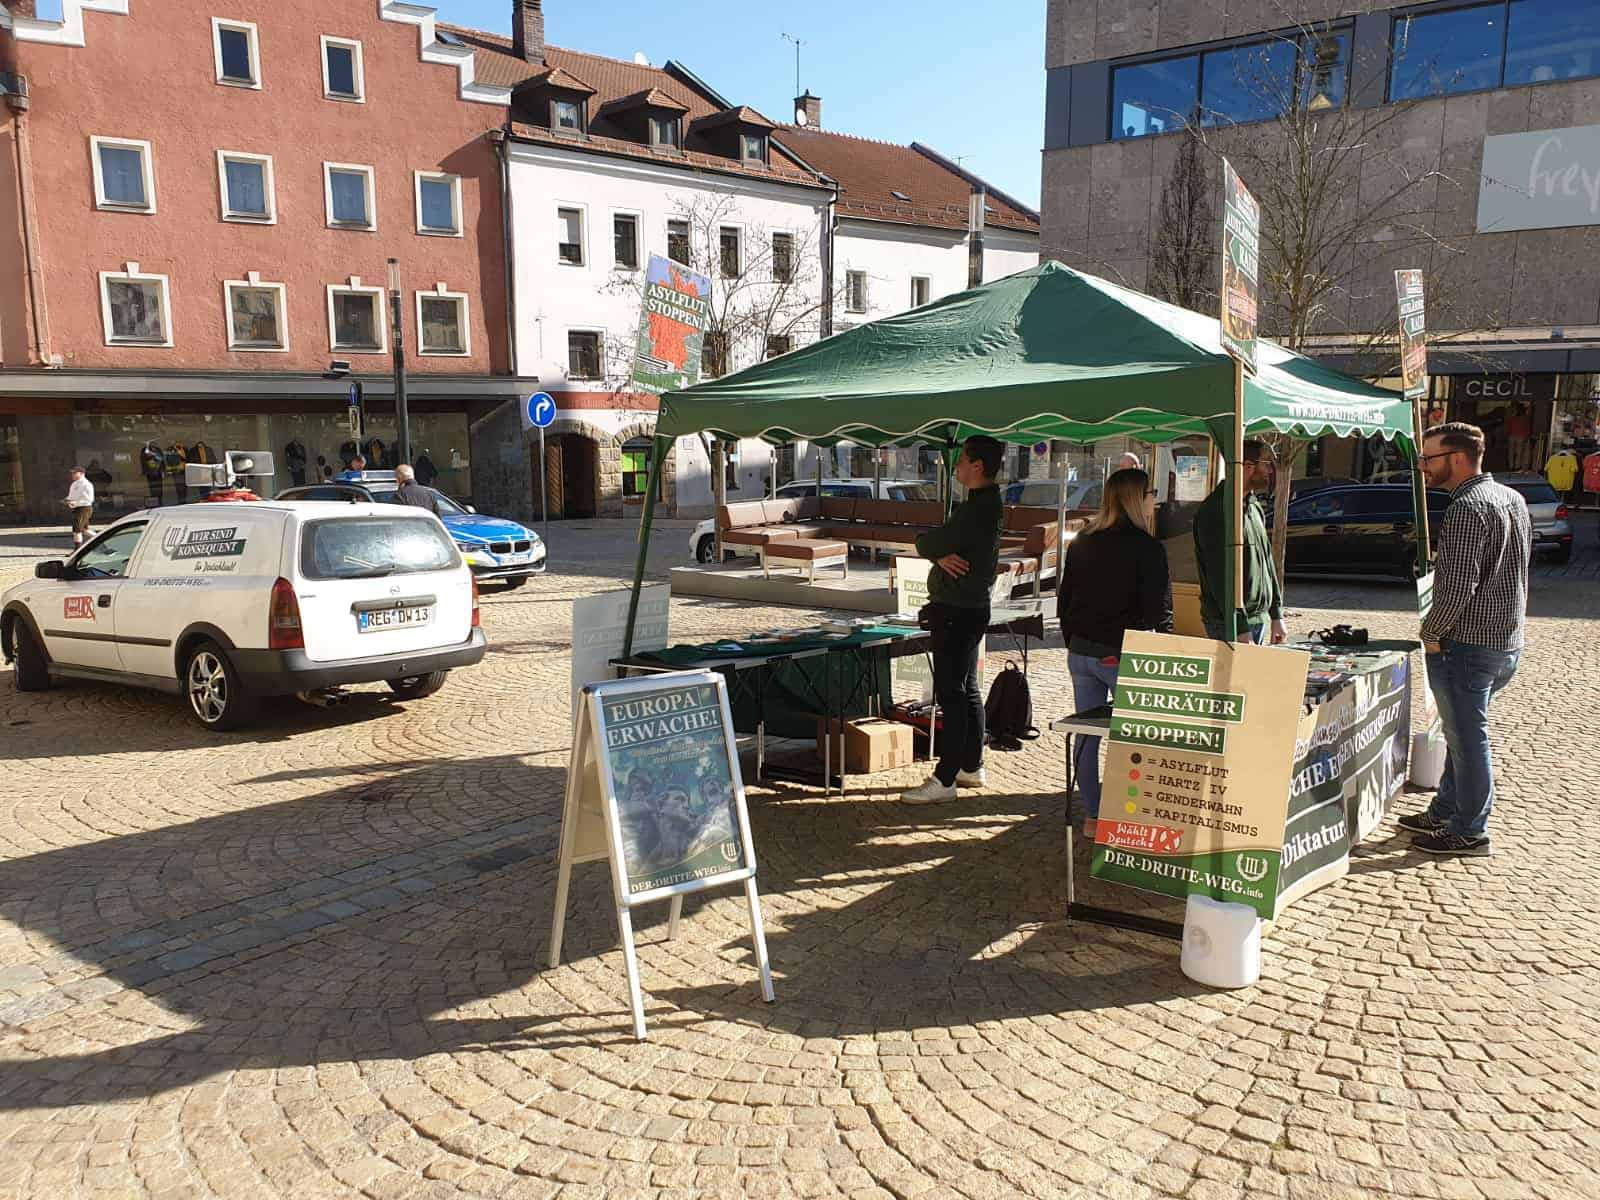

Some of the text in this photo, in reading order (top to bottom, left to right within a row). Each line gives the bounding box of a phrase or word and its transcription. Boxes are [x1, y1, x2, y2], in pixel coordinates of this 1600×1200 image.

[648, 284, 707, 313] ASYLFLUT
[648, 299, 705, 329] STOPPEN!
[1465, 379, 1533, 397] CECIL
[192, 528, 233, 542] WIR SIND
[178, 541, 237, 556] KONSEQUENT
[367, 608, 428, 627] REG DW 13
[1131, 658, 1205, 678] VOLKS-
[611, 691, 697, 722] EUROPA
[1125, 691, 1237, 716] VERRÄTER
[608, 709, 719, 746] ERWACHE!
[1120, 722, 1220, 748] STOPPEN!
[1160, 758, 1229, 779] ASYLFLUT
[1158, 775, 1200, 791] HARTZ
[1210, 784, 1227, 796] IV
[1156, 791, 1243, 816] GENDERWAHN
[1117, 823, 1148, 837] Wählt
[1154, 807, 1258, 837] KAPITALISMUS
[1104, 850, 1263, 899] DER-DRITTE-WEG.info
